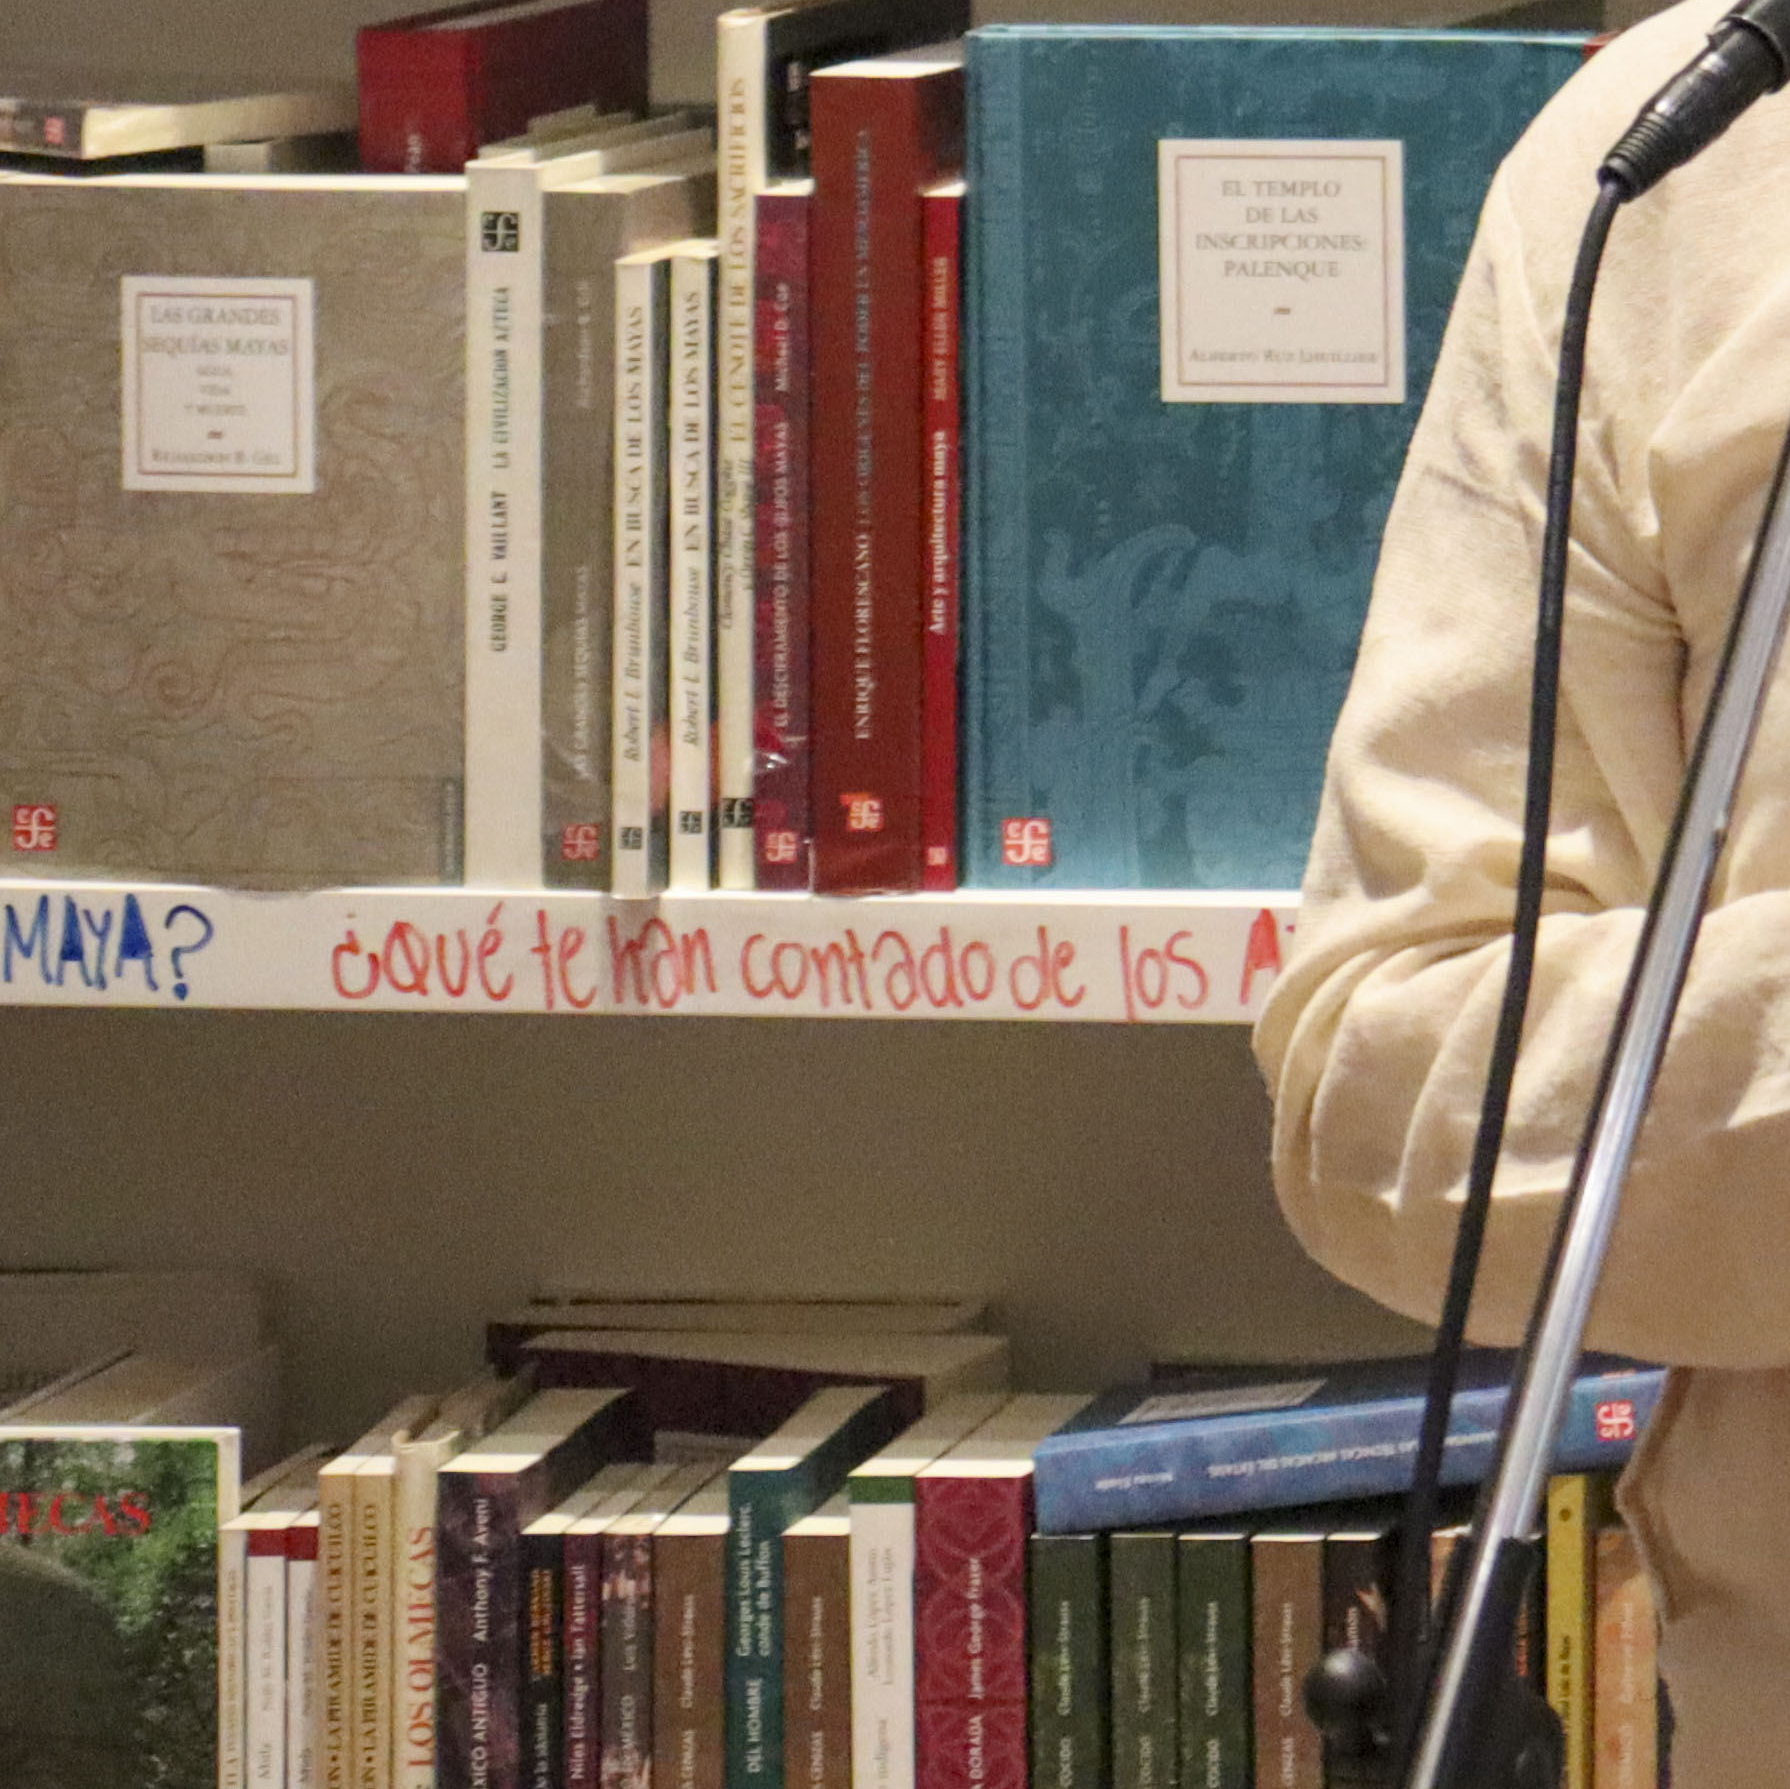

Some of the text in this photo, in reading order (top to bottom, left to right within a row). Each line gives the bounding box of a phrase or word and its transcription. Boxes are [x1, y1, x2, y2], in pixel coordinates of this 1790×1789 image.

[1221, 180, 1342, 197] EL TEMPLO
[1245, 206, 1320, 224] DE LAS
[1223, 260, 1340, 283] PALENQUE
[683, 291, 701, 552] EN BUSCA DE LOS MAYAS
[2, 893, 214, 1003] MAYA?
[332, 900, 1208, 1023] ¿Qué te han contado de los
[472, 1497, 488, 1547] Aveni
[472, 1568, 492, 1643] Anthony
[406, 1526, 435, 1768] LOS OLMECAS
[472, 1664, 488, 1743] ANTIGUO
